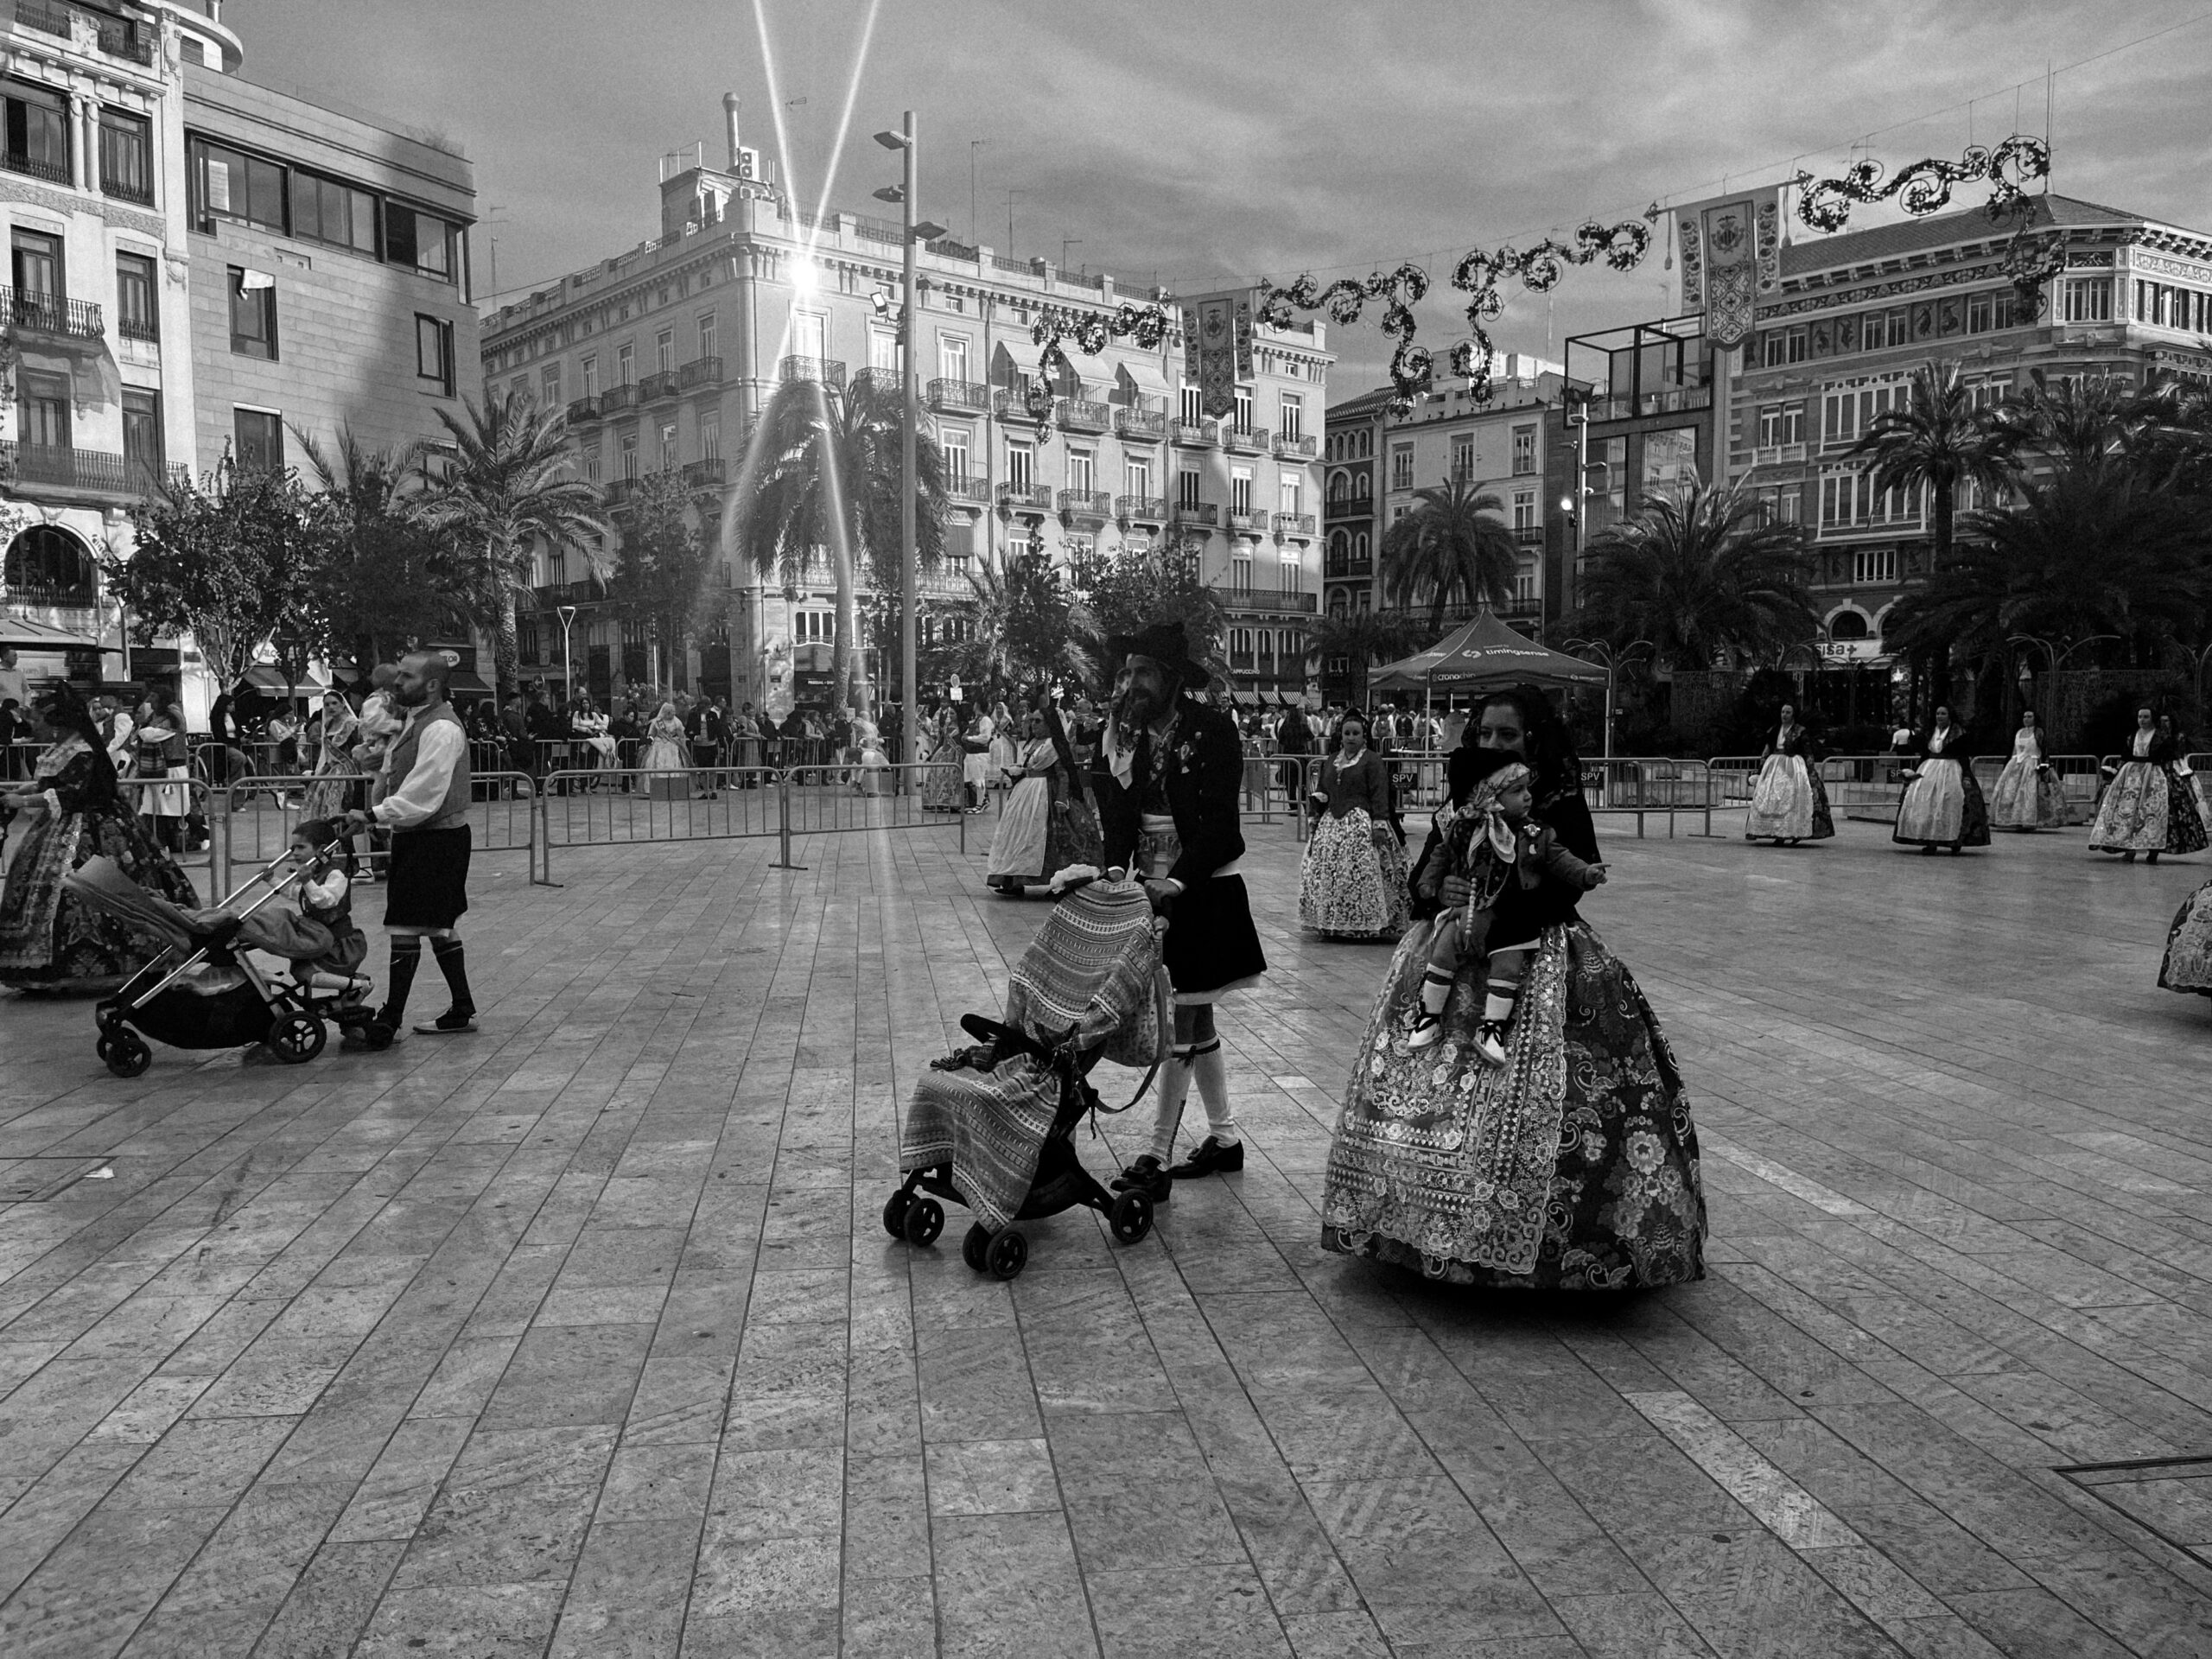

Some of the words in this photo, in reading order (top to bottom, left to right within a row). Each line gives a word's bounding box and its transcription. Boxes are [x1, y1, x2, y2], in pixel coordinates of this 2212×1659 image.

[256, 649, 277, 658] VALO
[1486, 648, 1549, 657] timingsense
[1392, 773, 1414, 783] SPV
[1580, 772, 1600, 781] SPV
[1890, 769, 1902, 778] SP
